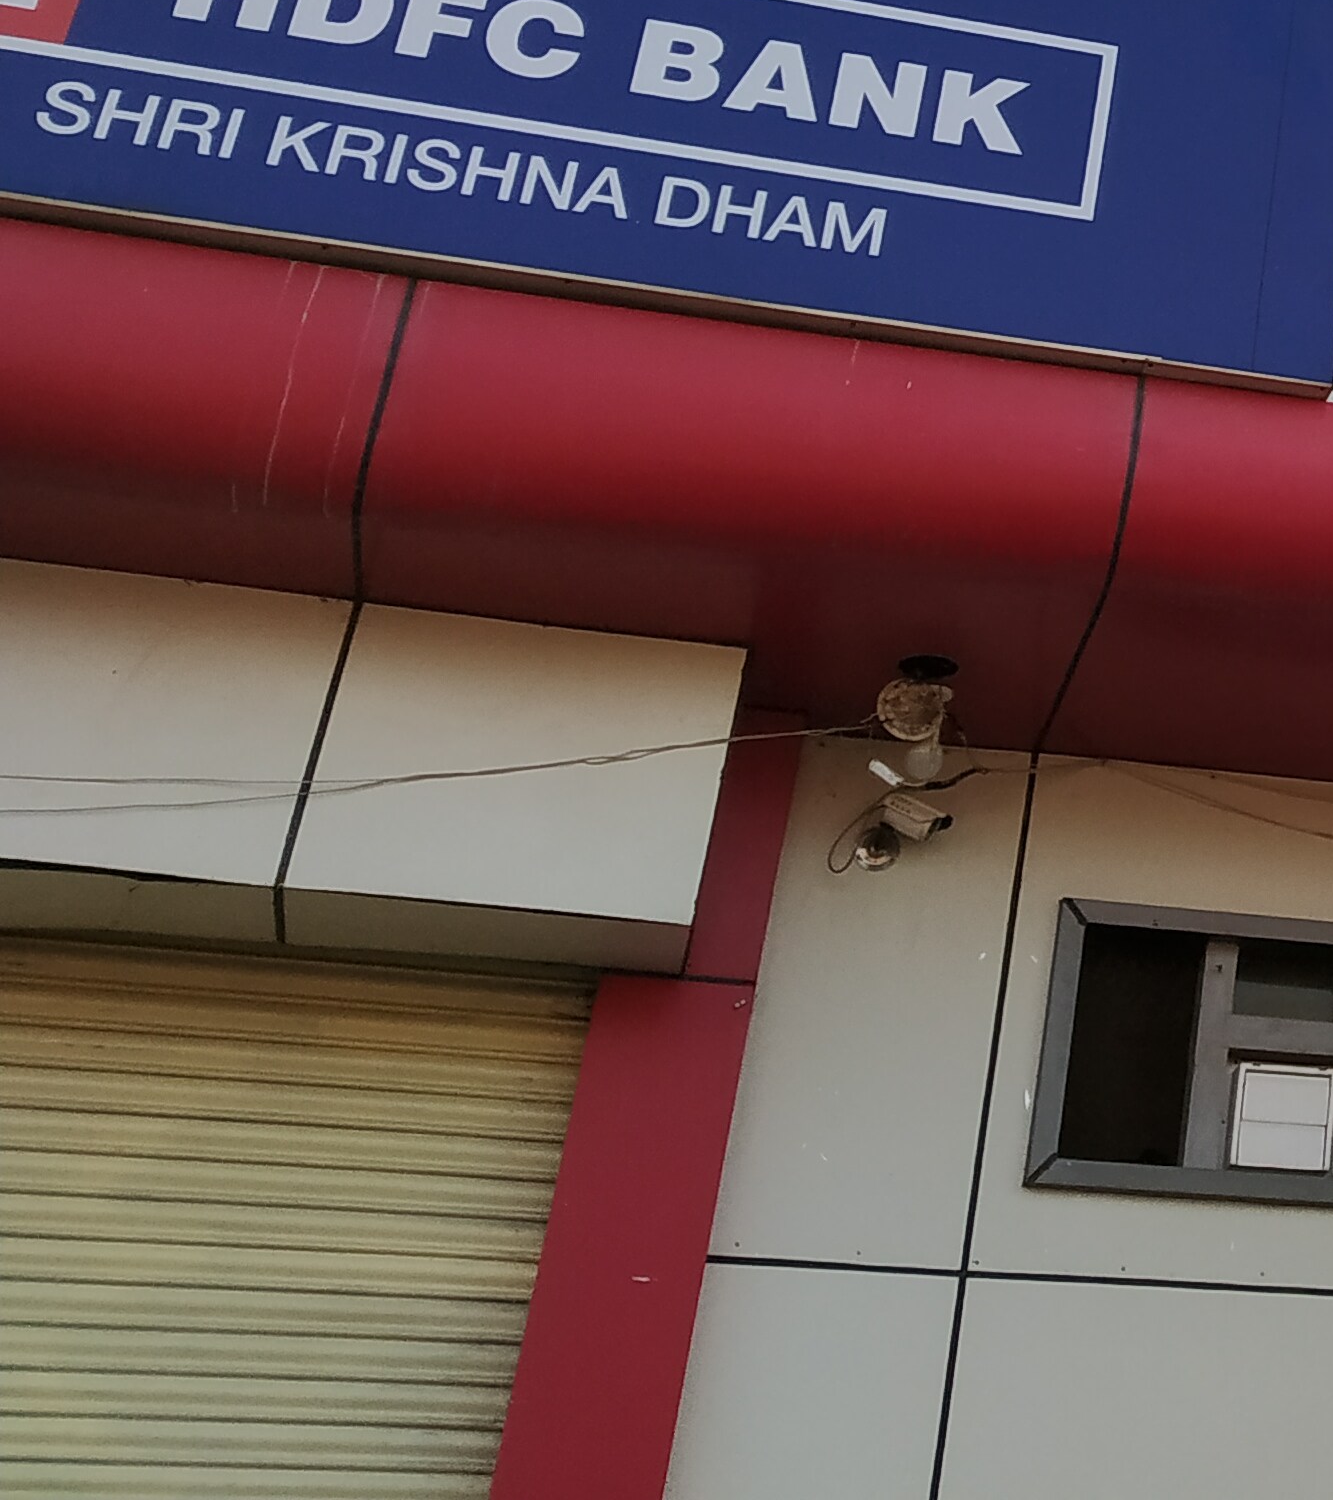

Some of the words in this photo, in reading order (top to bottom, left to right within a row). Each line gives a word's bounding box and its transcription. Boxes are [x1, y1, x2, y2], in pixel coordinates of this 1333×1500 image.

[629, 17, 1032, 157] BANK
[36, 81, 246, 160] SHRI
[265, 115, 629, 221] KRISHNA
[654, 175, 888, 258] DHAM
